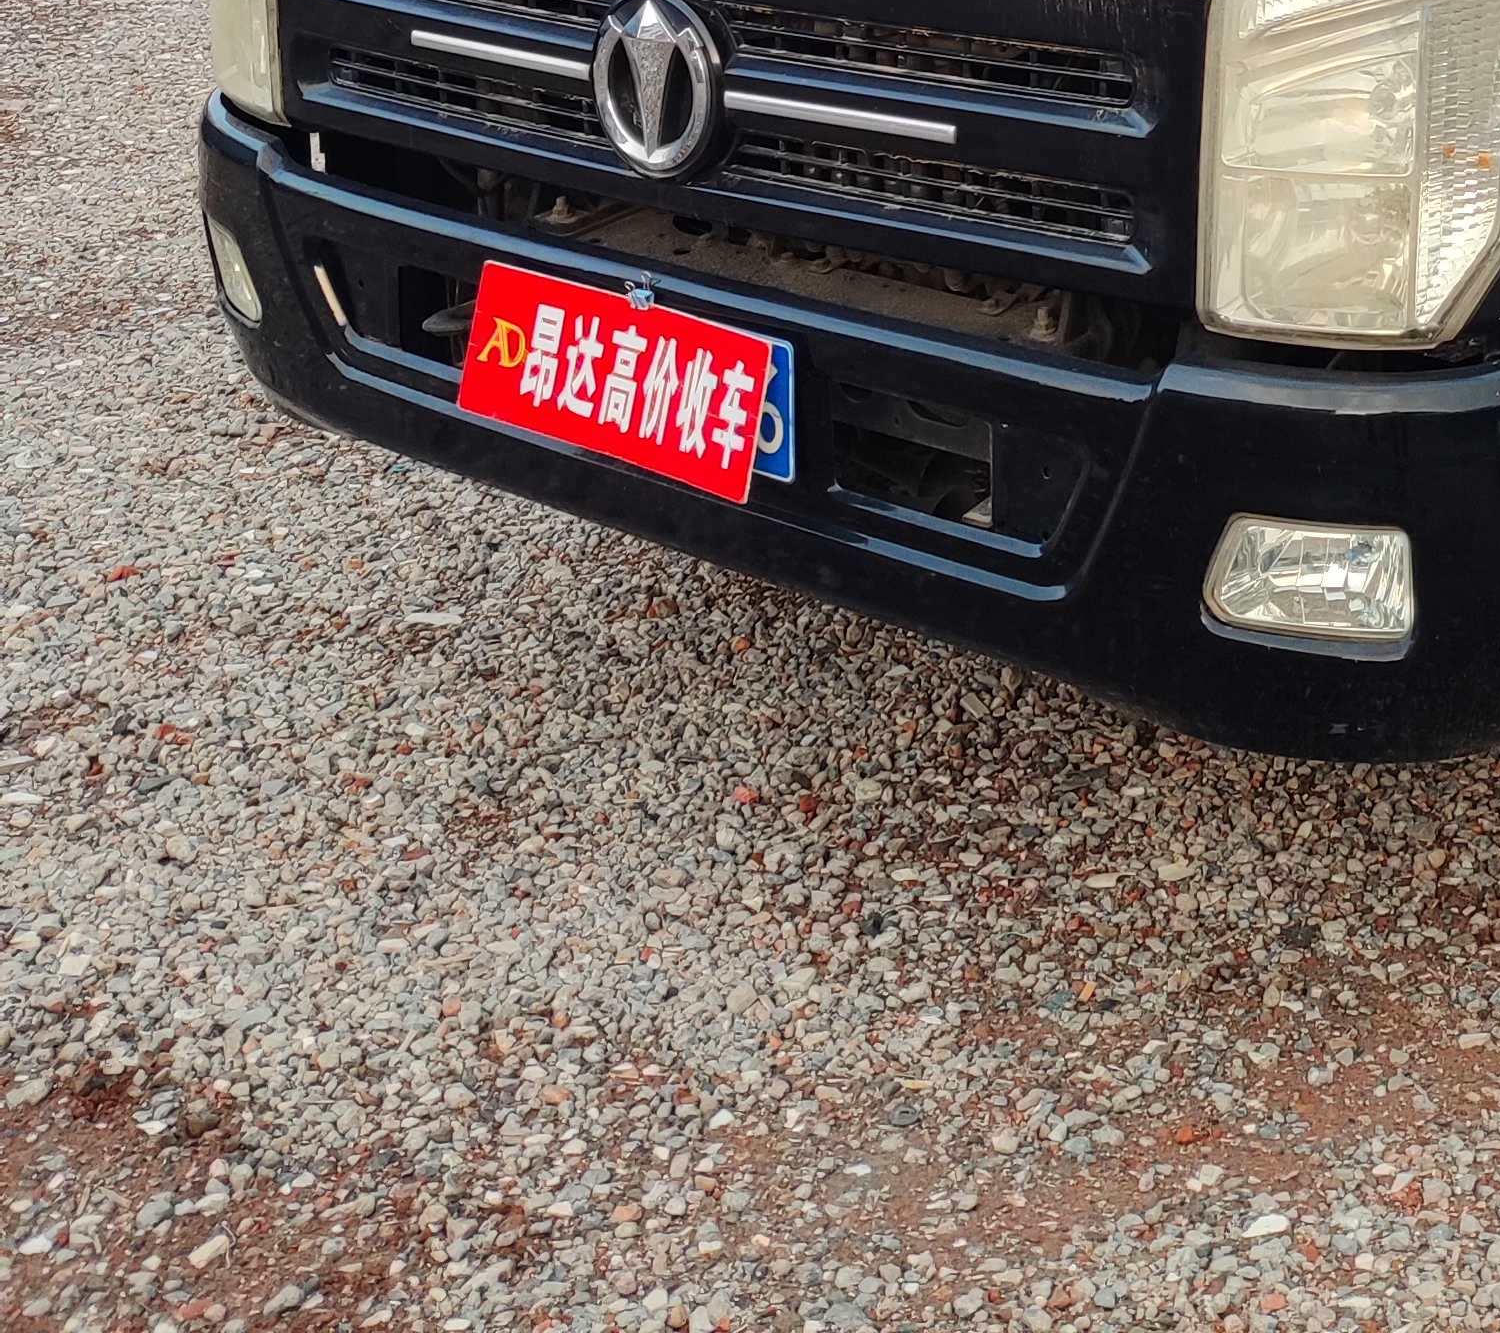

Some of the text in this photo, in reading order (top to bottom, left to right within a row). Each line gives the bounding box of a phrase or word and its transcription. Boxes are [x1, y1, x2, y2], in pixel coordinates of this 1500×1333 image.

[518, 302, 757, 471] 昂达高价收车
